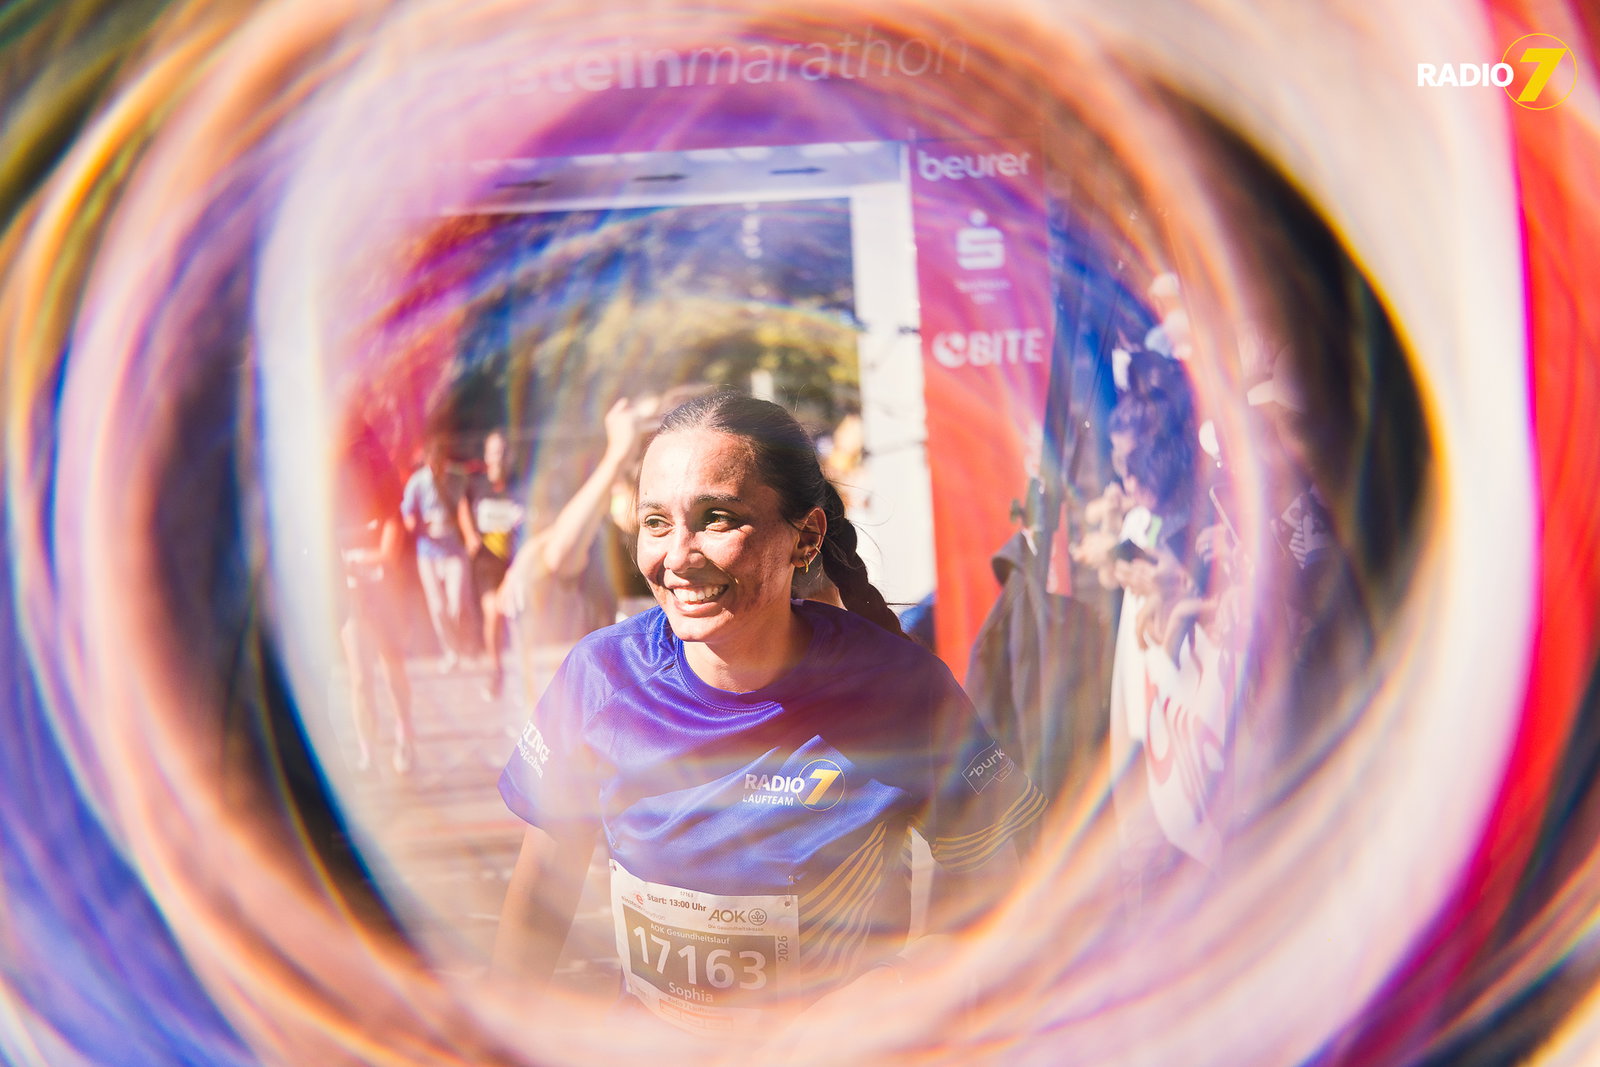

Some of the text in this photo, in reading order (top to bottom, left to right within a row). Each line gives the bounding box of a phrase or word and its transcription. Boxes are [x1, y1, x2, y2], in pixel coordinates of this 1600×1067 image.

[917, 150, 1031, 182] beurer
[968, 327, 1045, 367] BITE
[971, 748, 1005, 777] burk
[742, 794, 794, 807] LAUFTEAM
[744, 769, 841, 806] RADIO 7
[647, 894, 707, 911] Start: 13:00 Uhr
[708, 909, 747, 923] AOK
[650, 923, 730, 945] AOK Gesundheitslauf
[633, 925, 768, 990] 17163
[778, 935, 789, 962] 2026
[668, 982, 714, 1003] Sophia
